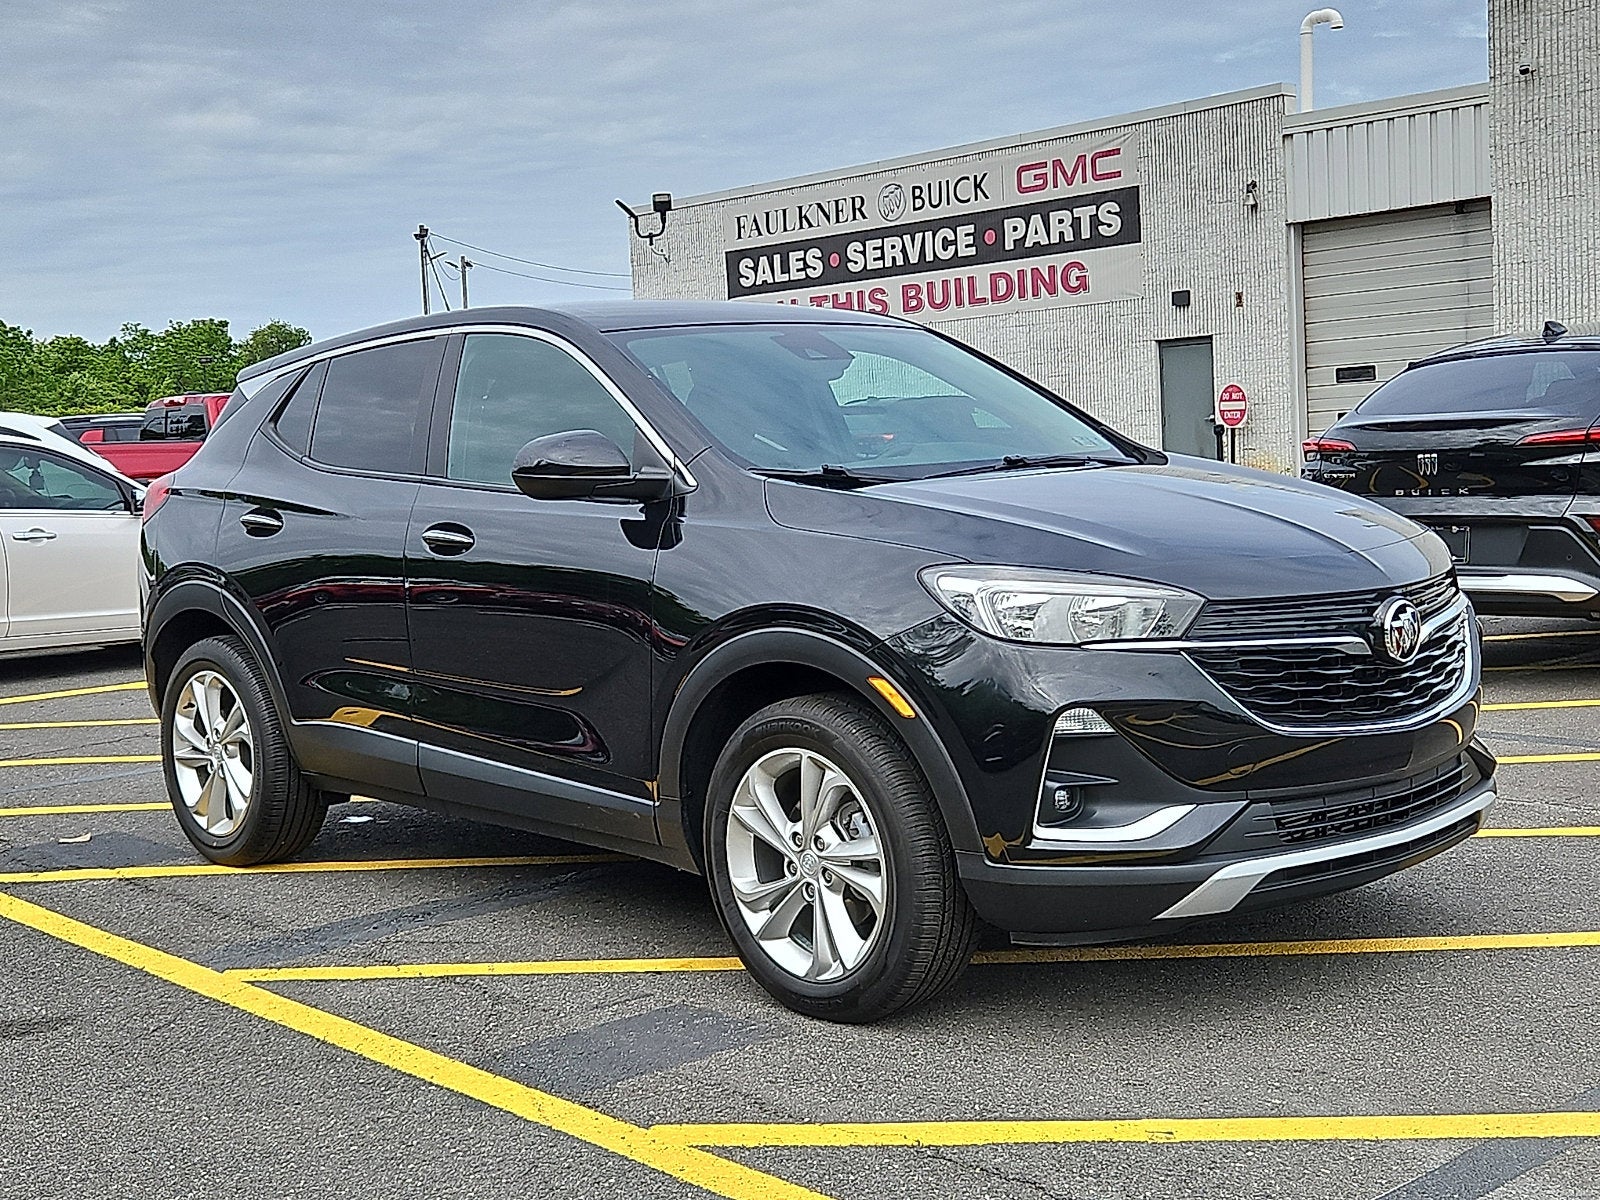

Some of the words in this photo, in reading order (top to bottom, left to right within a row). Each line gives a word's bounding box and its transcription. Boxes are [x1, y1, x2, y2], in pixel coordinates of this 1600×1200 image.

[735, 195, 868, 240] FAULKNER
[911, 172, 990, 212] BUICK
[1016, 148, 1122, 194] GMC
[738, 247, 824, 288] SALES
[846, 224, 976, 274] SERVICE
[1003, 201, 1122, 251] PARTS
[901, 261, 1090, 313] BUILDING
[1222, 392, 1230, 400] DO
[1231, 391, 1243, 400] NOT
[1223, 411, 1241, 419] ENTER
[1395, 487, 1470, 496] BUICK
